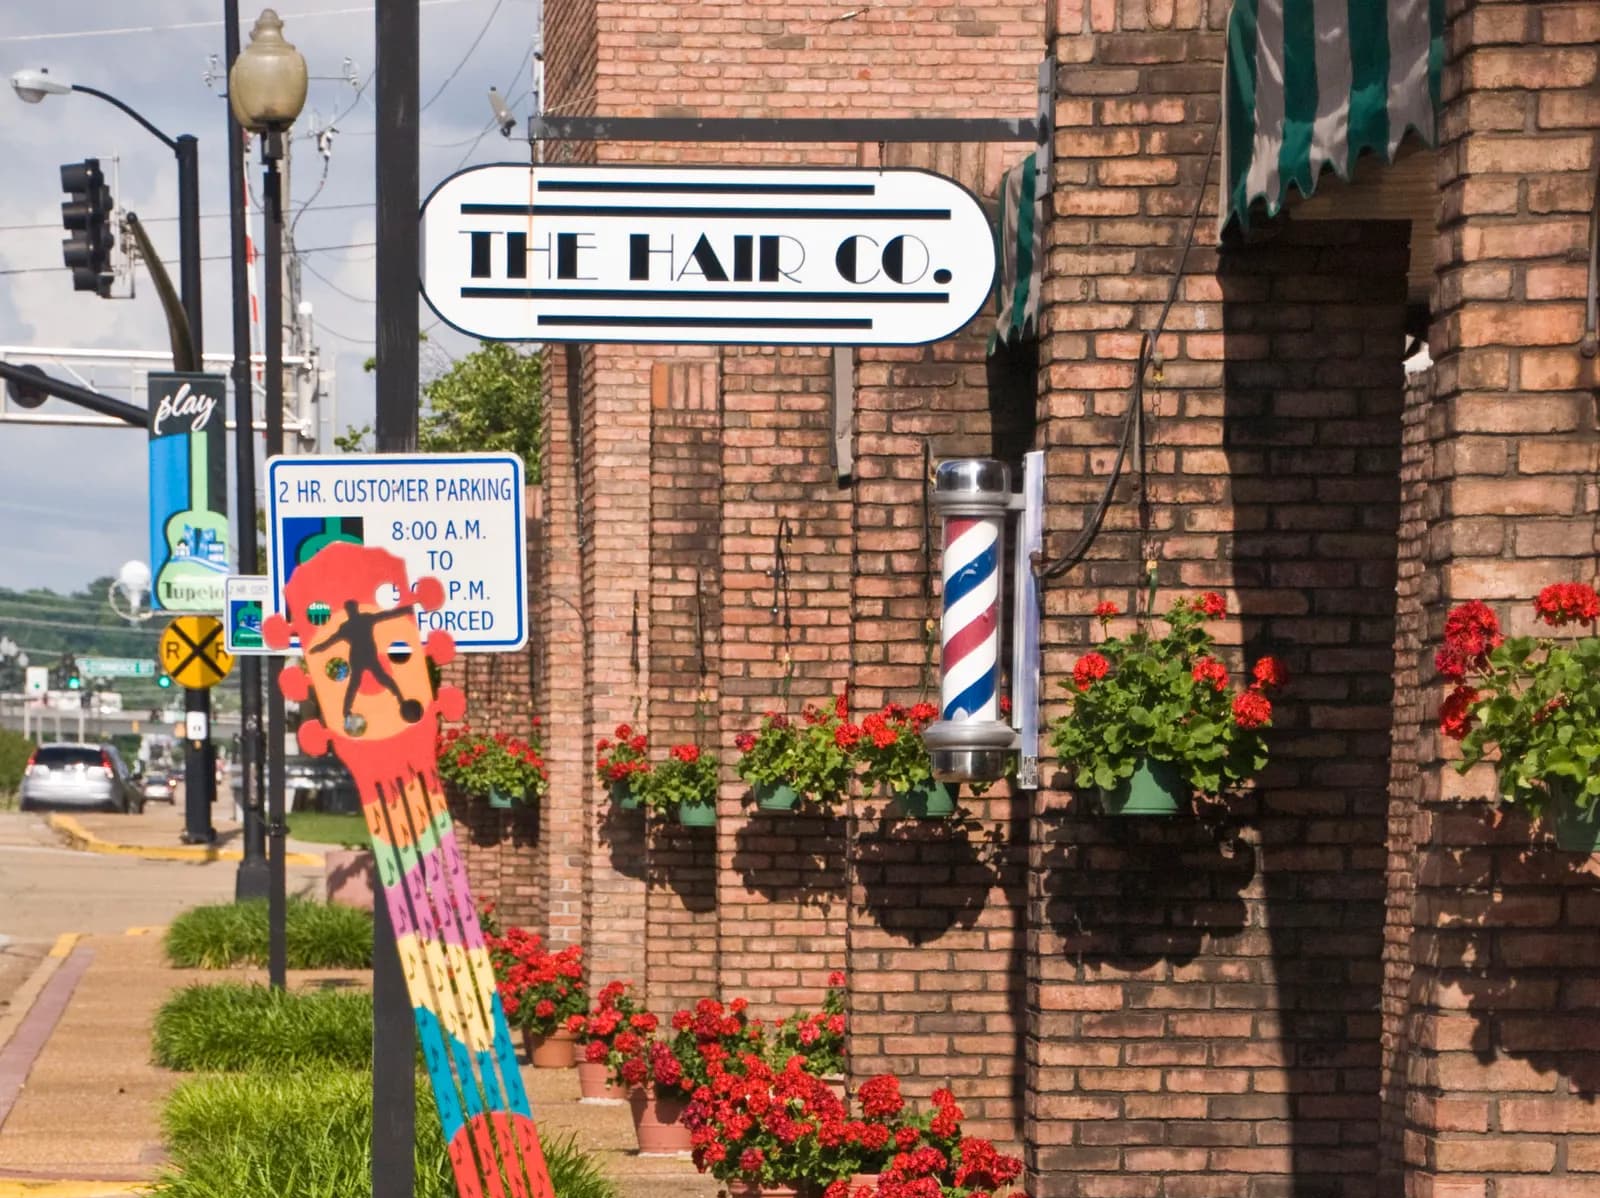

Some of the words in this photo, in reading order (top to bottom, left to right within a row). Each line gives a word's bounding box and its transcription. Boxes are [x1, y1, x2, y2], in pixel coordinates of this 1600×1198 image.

[458, 231, 599, 280] THE
[629, 232, 806, 284] HAIR
[835, 234, 953, 286] CO.
[154, 383, 218, 436] play
[279, 481, 290, 503] 2
[297, 480, 327, 503] HR.
[334, 479, 429, 503] CUSTOMER
[436, 478, 512, 502] PARKING
[391, 520, 438, 541] 8:00
[444, 519, 487, 540] A.M.
[427, 550, 453, 571] TO
[162, 580, 226, 601] Tupelo
[449, 580, 491, 601] P.M.
[417, 610, 494, 631] FORCED
[166, 641, 180, 660] R
[215, 641, 229, 660] R
